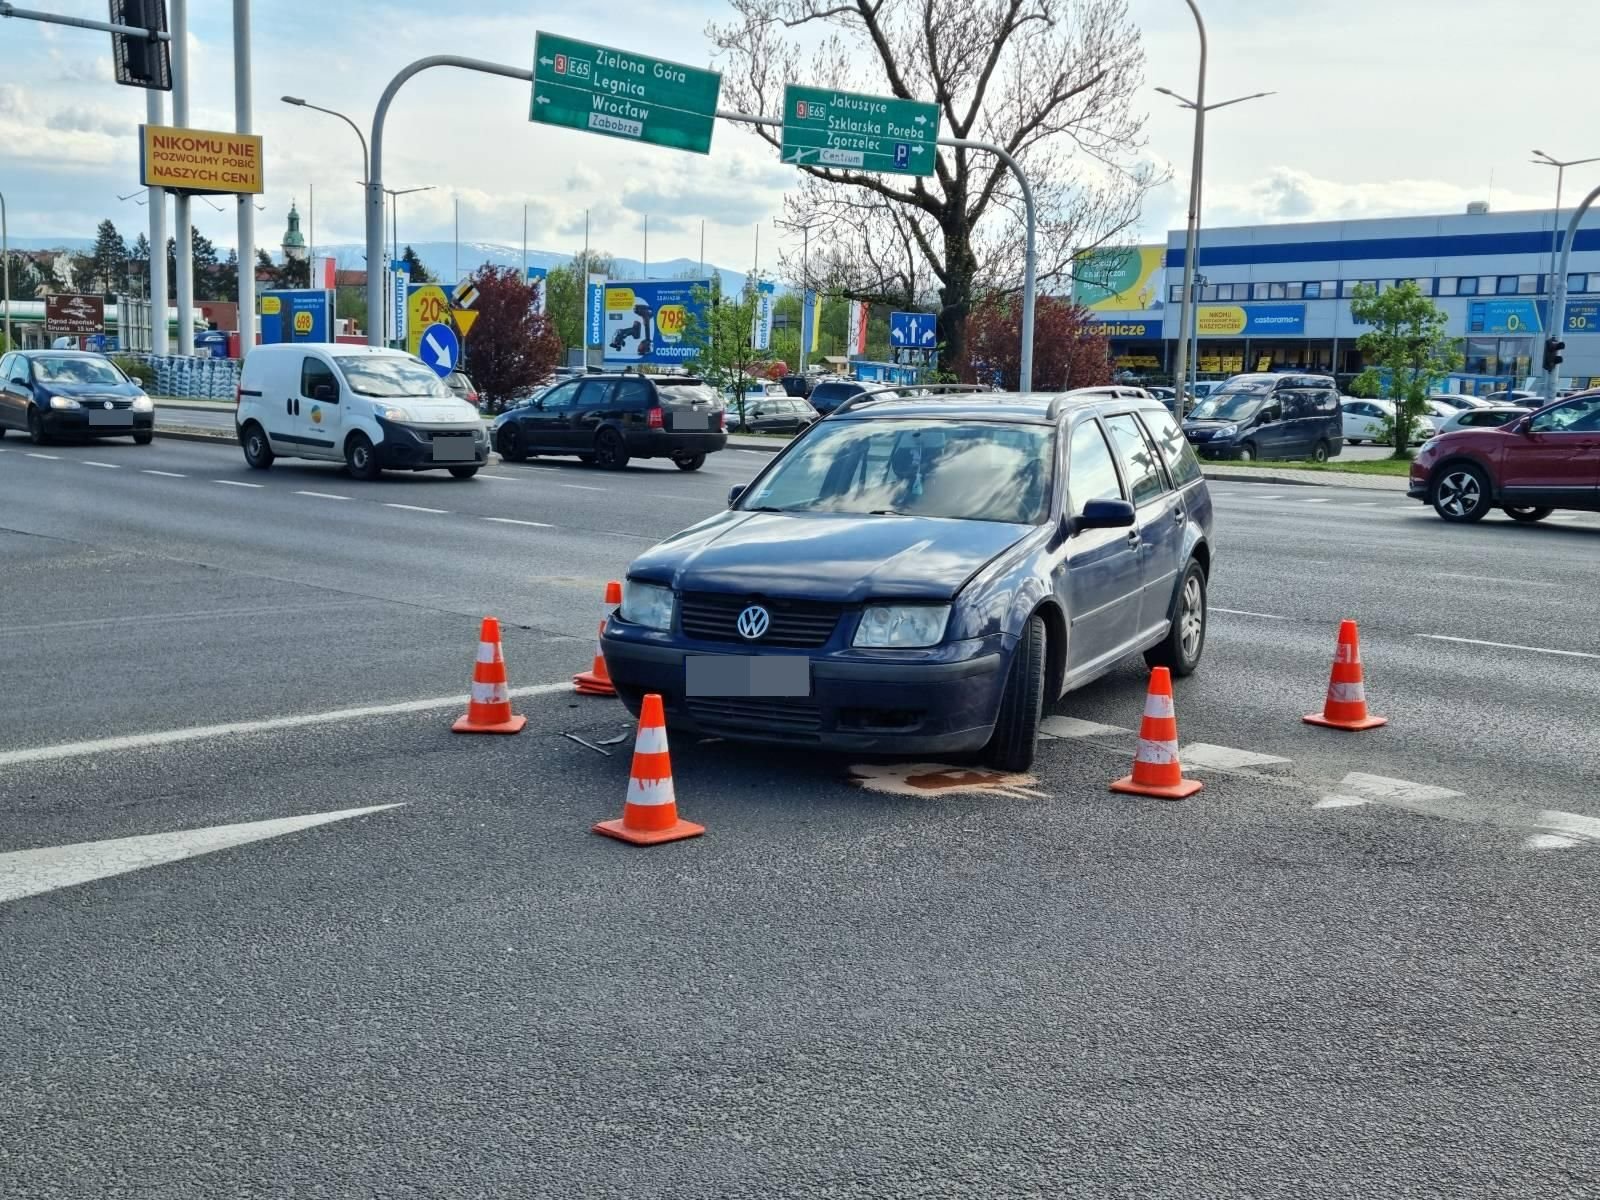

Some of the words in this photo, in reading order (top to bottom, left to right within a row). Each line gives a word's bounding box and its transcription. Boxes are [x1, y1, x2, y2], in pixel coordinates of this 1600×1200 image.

[556, 56, 565, 71] 3
[569, 61, 590, 76] E65
[596, 50, 645, 74] Zielona
[653, 62, 686, 83] Góra
[593, 72, 645, 96] Legnica
[592, 95, 649, 120] Wrocław
[797, 102, 805, 115] 3
[809, 105, 825, 118] E65
[830, 95, 887, 114] Jakuszyce
[592, 115, 640, 134] Zabobrze
[828, 115, 881, 134] Szklarska
[887, 122, 924, 140] Poręba
[153, 135, 223, 154] NIKOMU
[228, 142, 255, 157] NIE
[827, 133, 880, 150] Zgorzelec
[153, 151, 219, 165] POZWOLIMY
[222, 157, 255, 169] POBIĆ
[822, 150, 861, 164] Centrum
[153, 166, 218, 181] NASZYCH
[221, 172, 248, 184] CEN
[296, 315, 311, 329] 698
[593, 288, 601, 344] castorama
[660, 311, 685, 329] 798
[759, 297, 768, 349] castorama
[1254, 315, 1293, 324] castorama
[1569, 316, 1586, 328] 30
[656, 346, 700, 357] castorama
